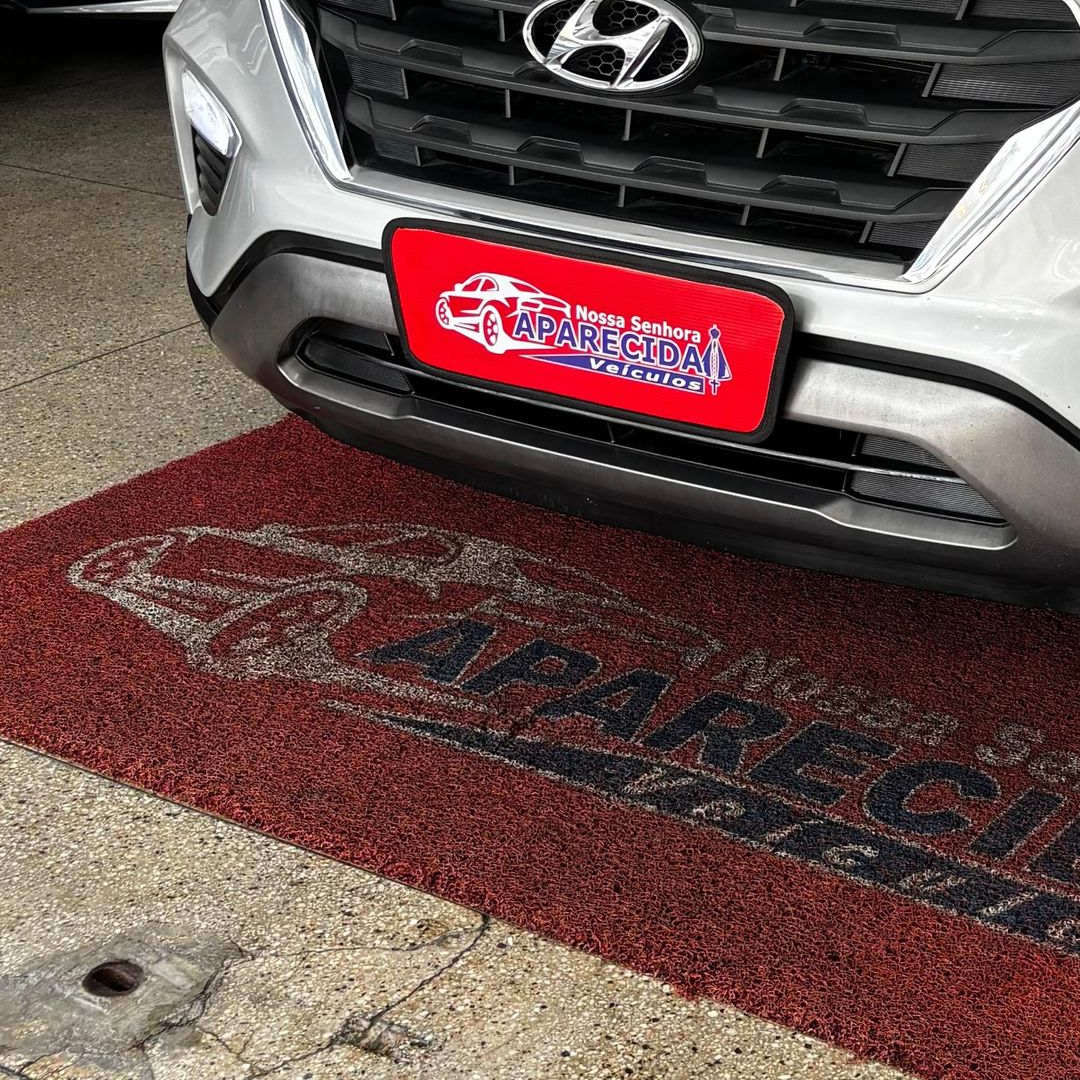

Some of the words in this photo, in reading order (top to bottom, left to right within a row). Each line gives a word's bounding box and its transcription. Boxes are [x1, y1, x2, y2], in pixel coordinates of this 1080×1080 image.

[512, 312, 704, 375] APARECIDA
[575, 305, 625, 329] Nossa
[630, 315, 701, 344] Senhora
[588, 356, 702, 392] Veículos
[712, 648, 958, 747] Nossa
